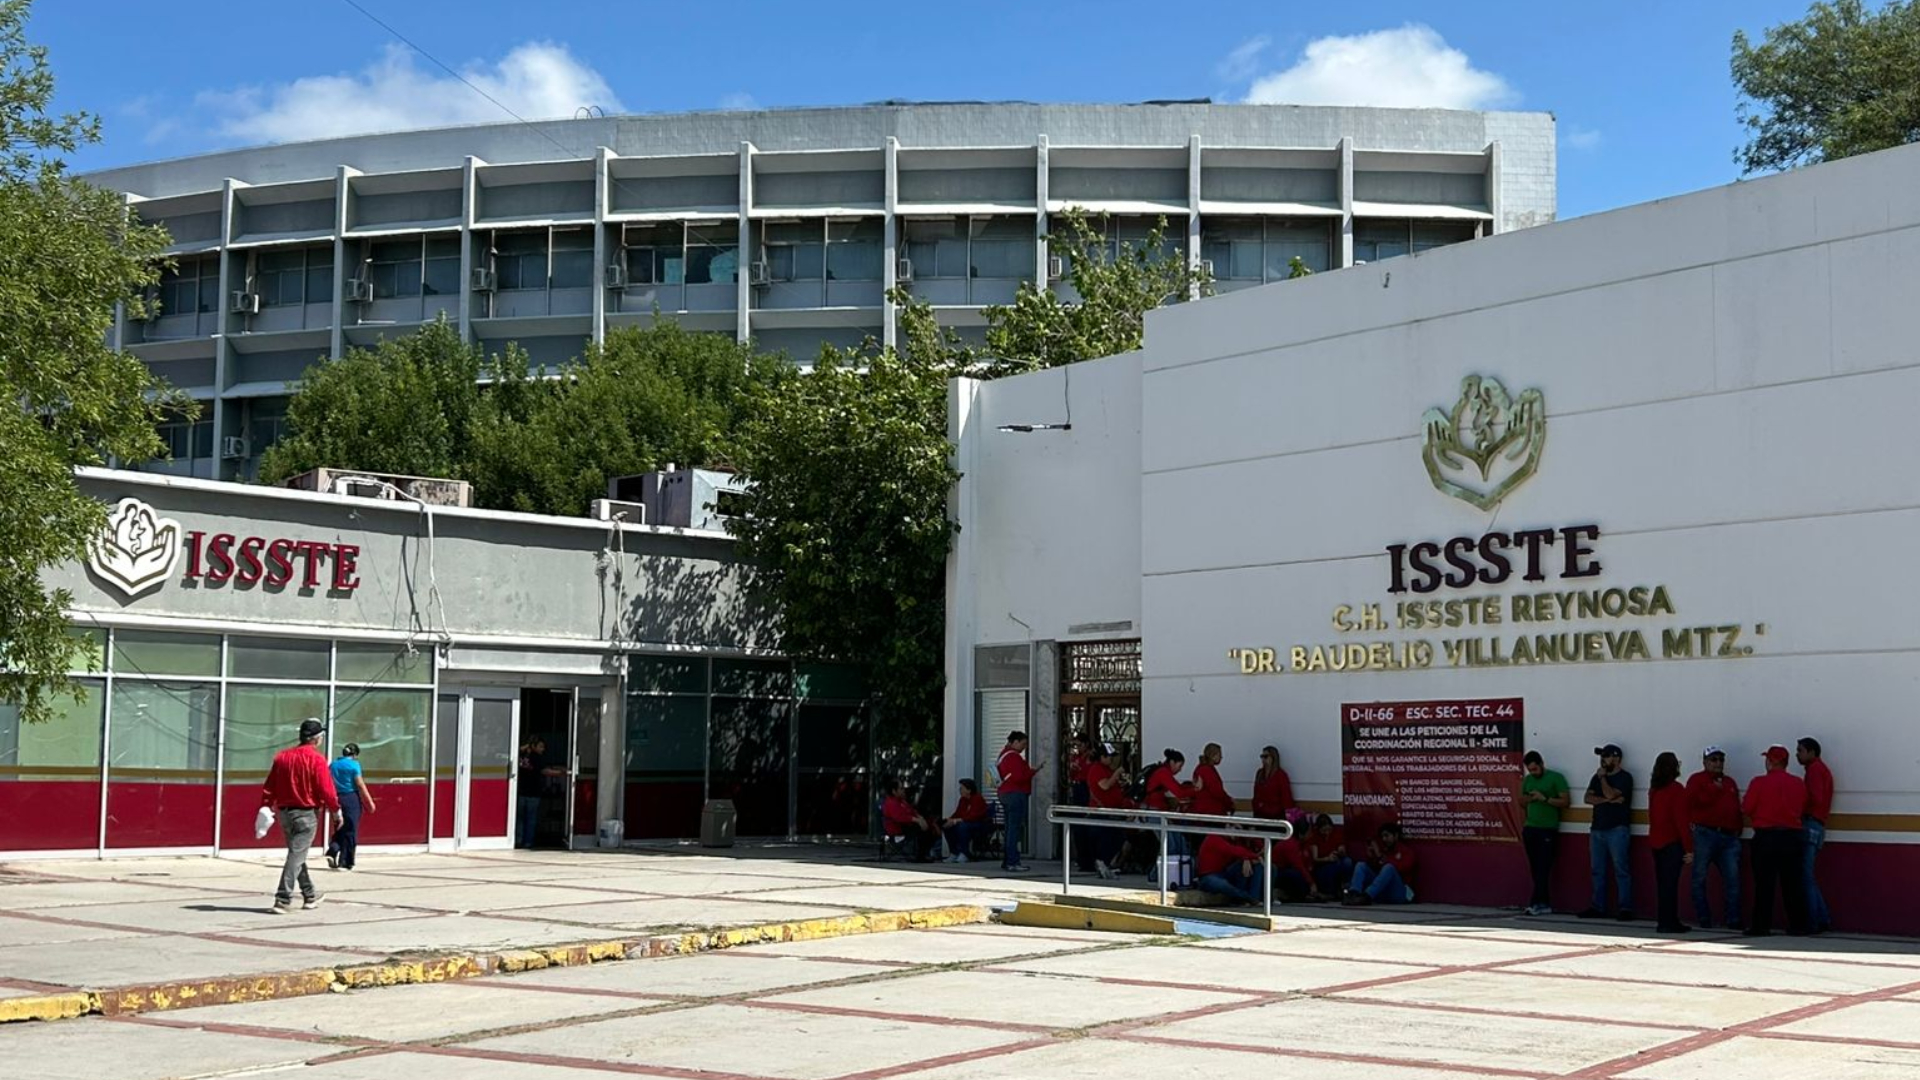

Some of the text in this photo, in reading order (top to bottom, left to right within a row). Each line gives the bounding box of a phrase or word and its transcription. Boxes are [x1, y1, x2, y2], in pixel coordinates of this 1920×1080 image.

[185, 530, 361, 590] ISSSTE
[1386, 525, 1602, 594] ISSSTE
[1333, 584, 1676, 632] C.H. ISSSTE REYNOSA
[1290, 639, 1434, 671] BAUDELIO
[1442, 630, 1652, 667] VILLANUEVA
[1350, 704, 1514, 721] D-II-66 ESC. SEC. TEC. 44
[1359, 725, 1499, 737] SE UNE A LAS PETICIONES DE LA
[1354, 738, 1422, 749] COORDINACIÓN
[1423, 738, 1468, 749] REGIONAL
[1482, 737, 1508, 748] SNTE
[1352, 756, 1365, 764] QUE
[1344, 794, 1396, 806] DEMANDAMOS:
